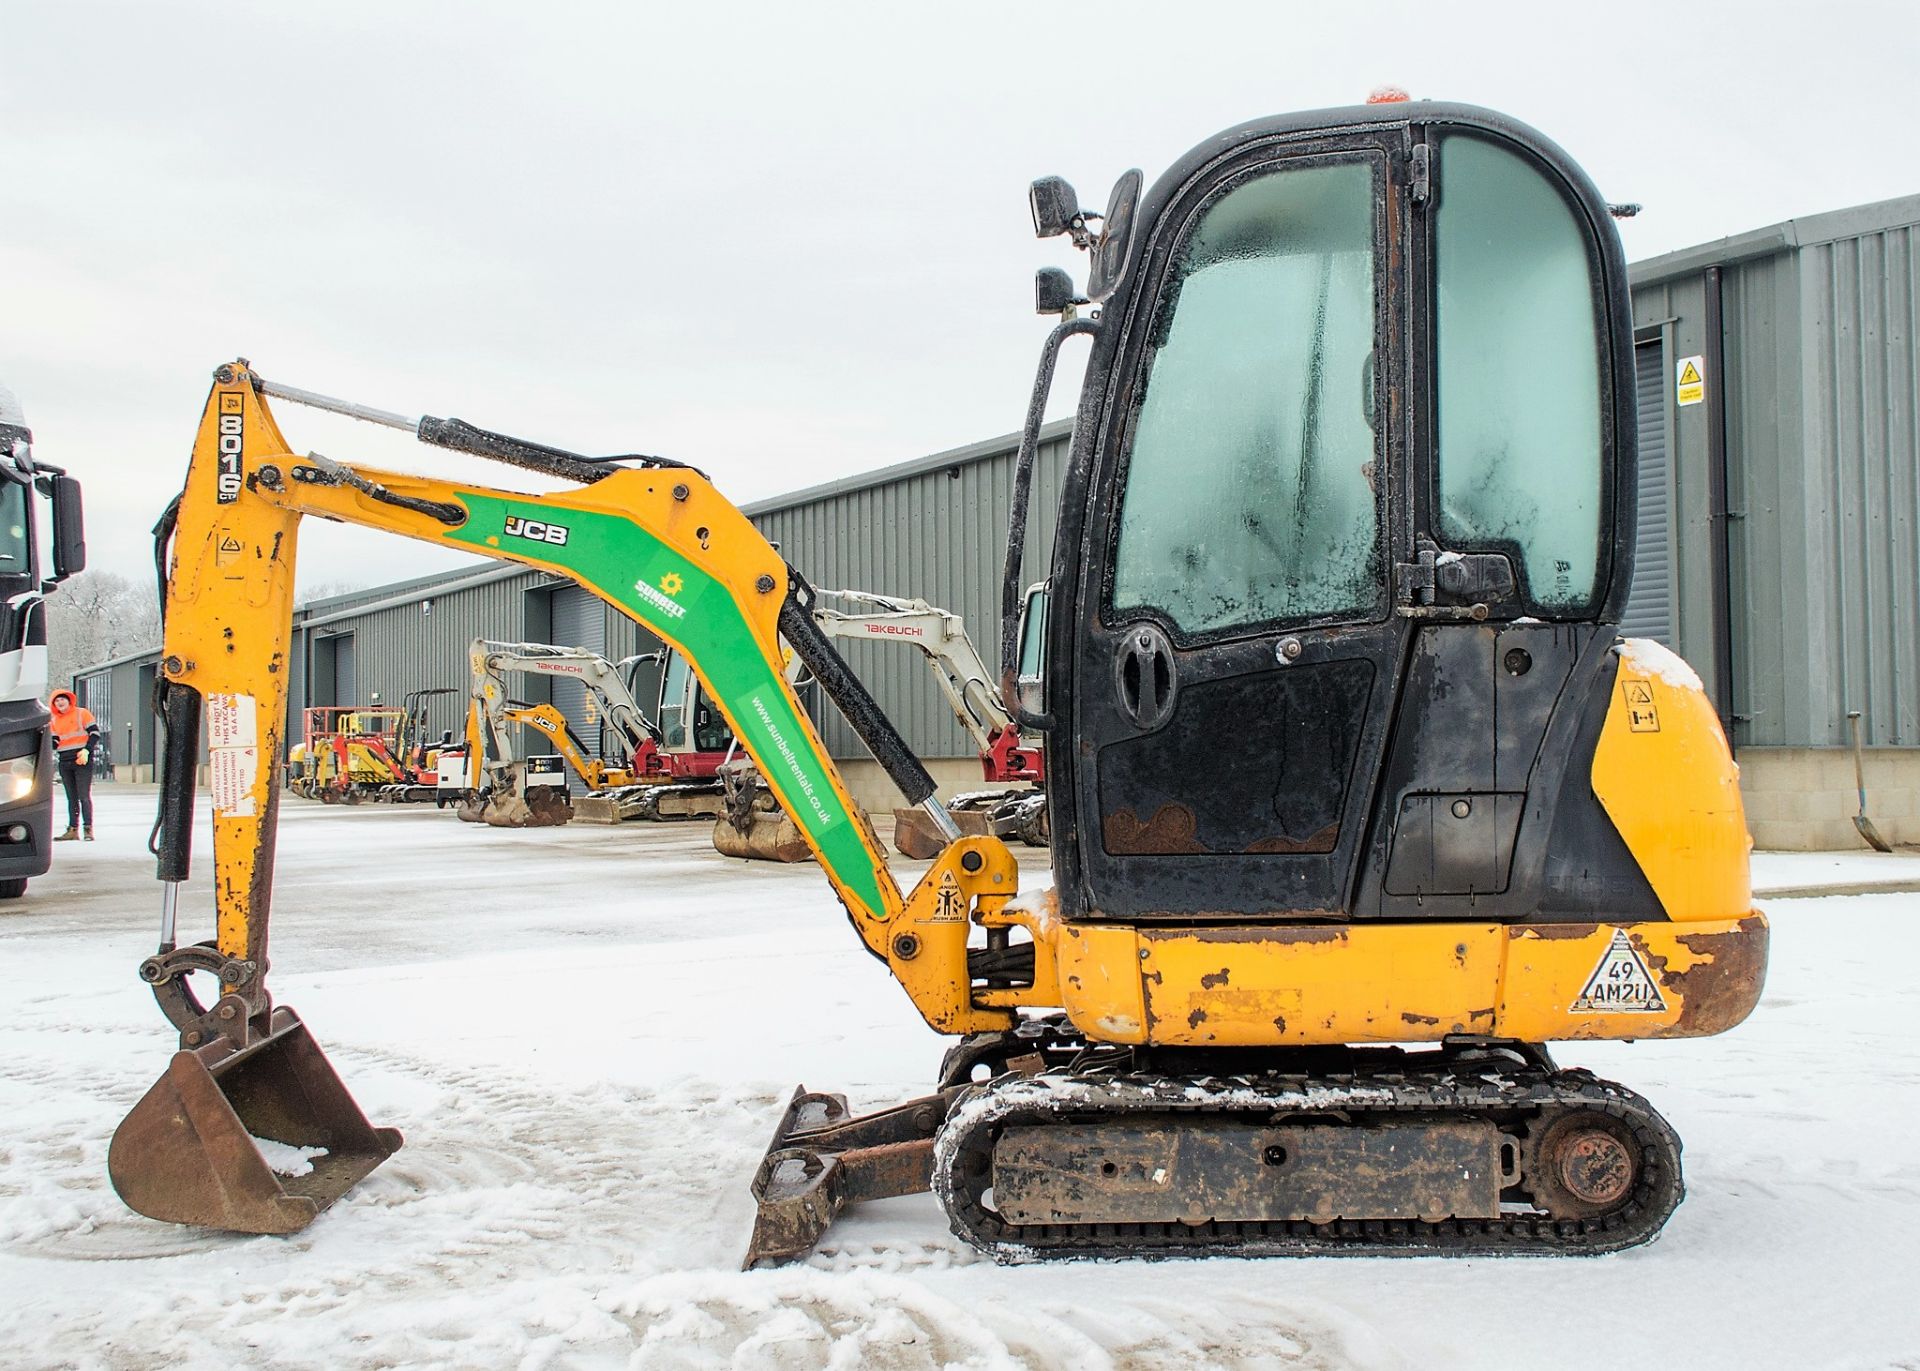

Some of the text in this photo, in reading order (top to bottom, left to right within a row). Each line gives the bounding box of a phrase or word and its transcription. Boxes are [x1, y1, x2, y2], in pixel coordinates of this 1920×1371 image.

[220, 415, 242, 493] 8016
[505, 518, 568, 545] JCB
[634, 579, 687, 618] SUNBELT
[638, 592, 674, 618] RENTALS
[214, 725, 221, 737] DO
[533, 715, 558, 732] JCB
[751, 696, 831, 825] www.sunbeltrentals.co.uk
[1608, 961, 1634, 981] 49
[1594, 983, 1648, 1003] AM2U
